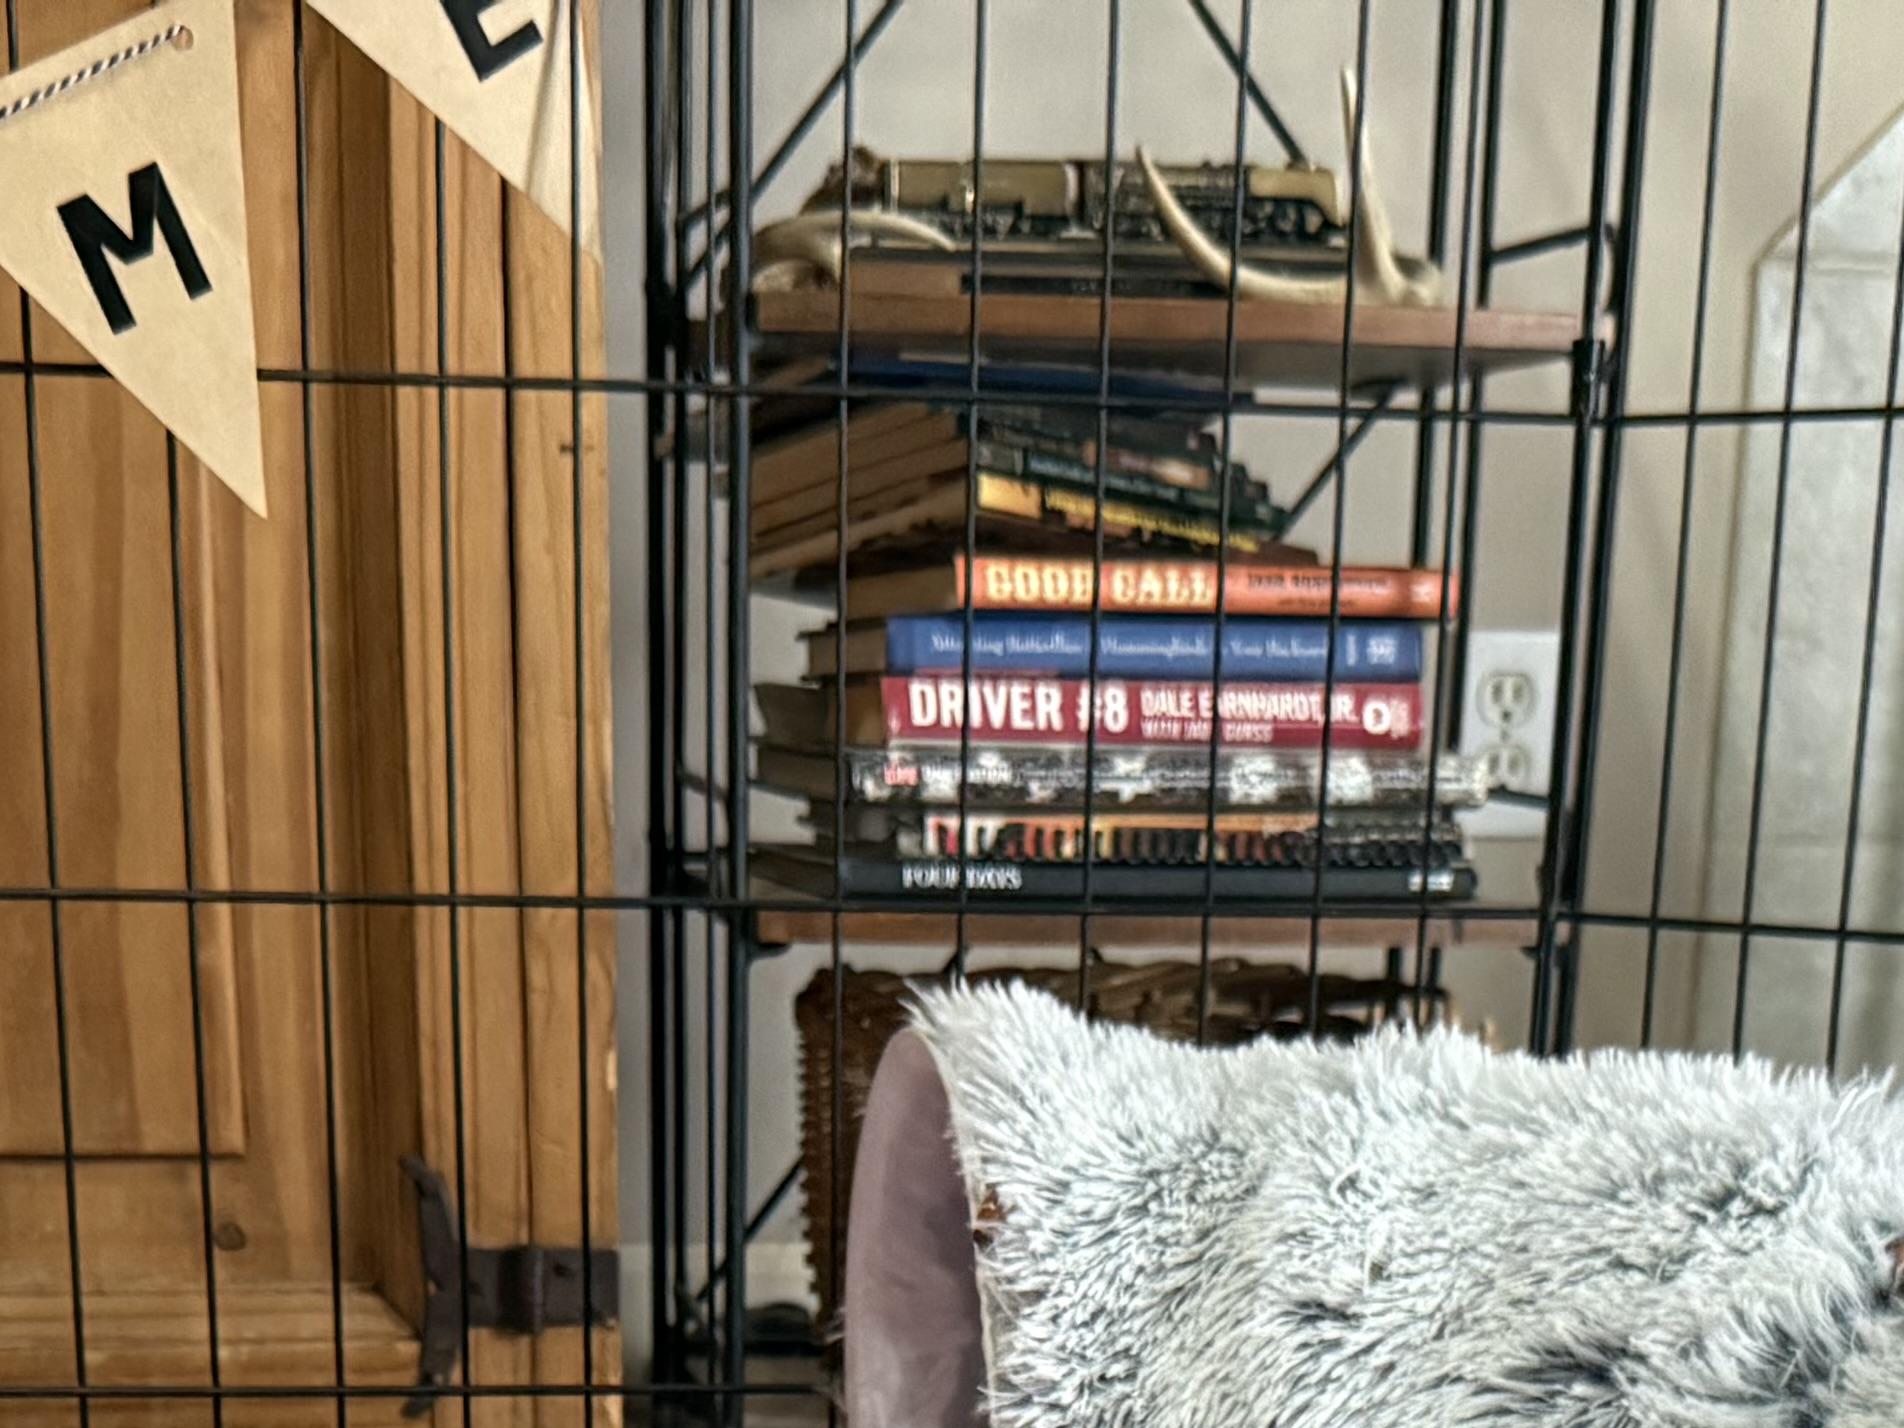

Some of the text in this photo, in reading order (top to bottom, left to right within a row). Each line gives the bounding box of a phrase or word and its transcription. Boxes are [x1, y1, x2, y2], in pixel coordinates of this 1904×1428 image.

[986, 564, 1094, 603] GOOD
[1112, 568, 1215, 607] CALL
[909, 679, 1129, 733] DRIVER #8
[1141, 688, 1194, 718] DALE
